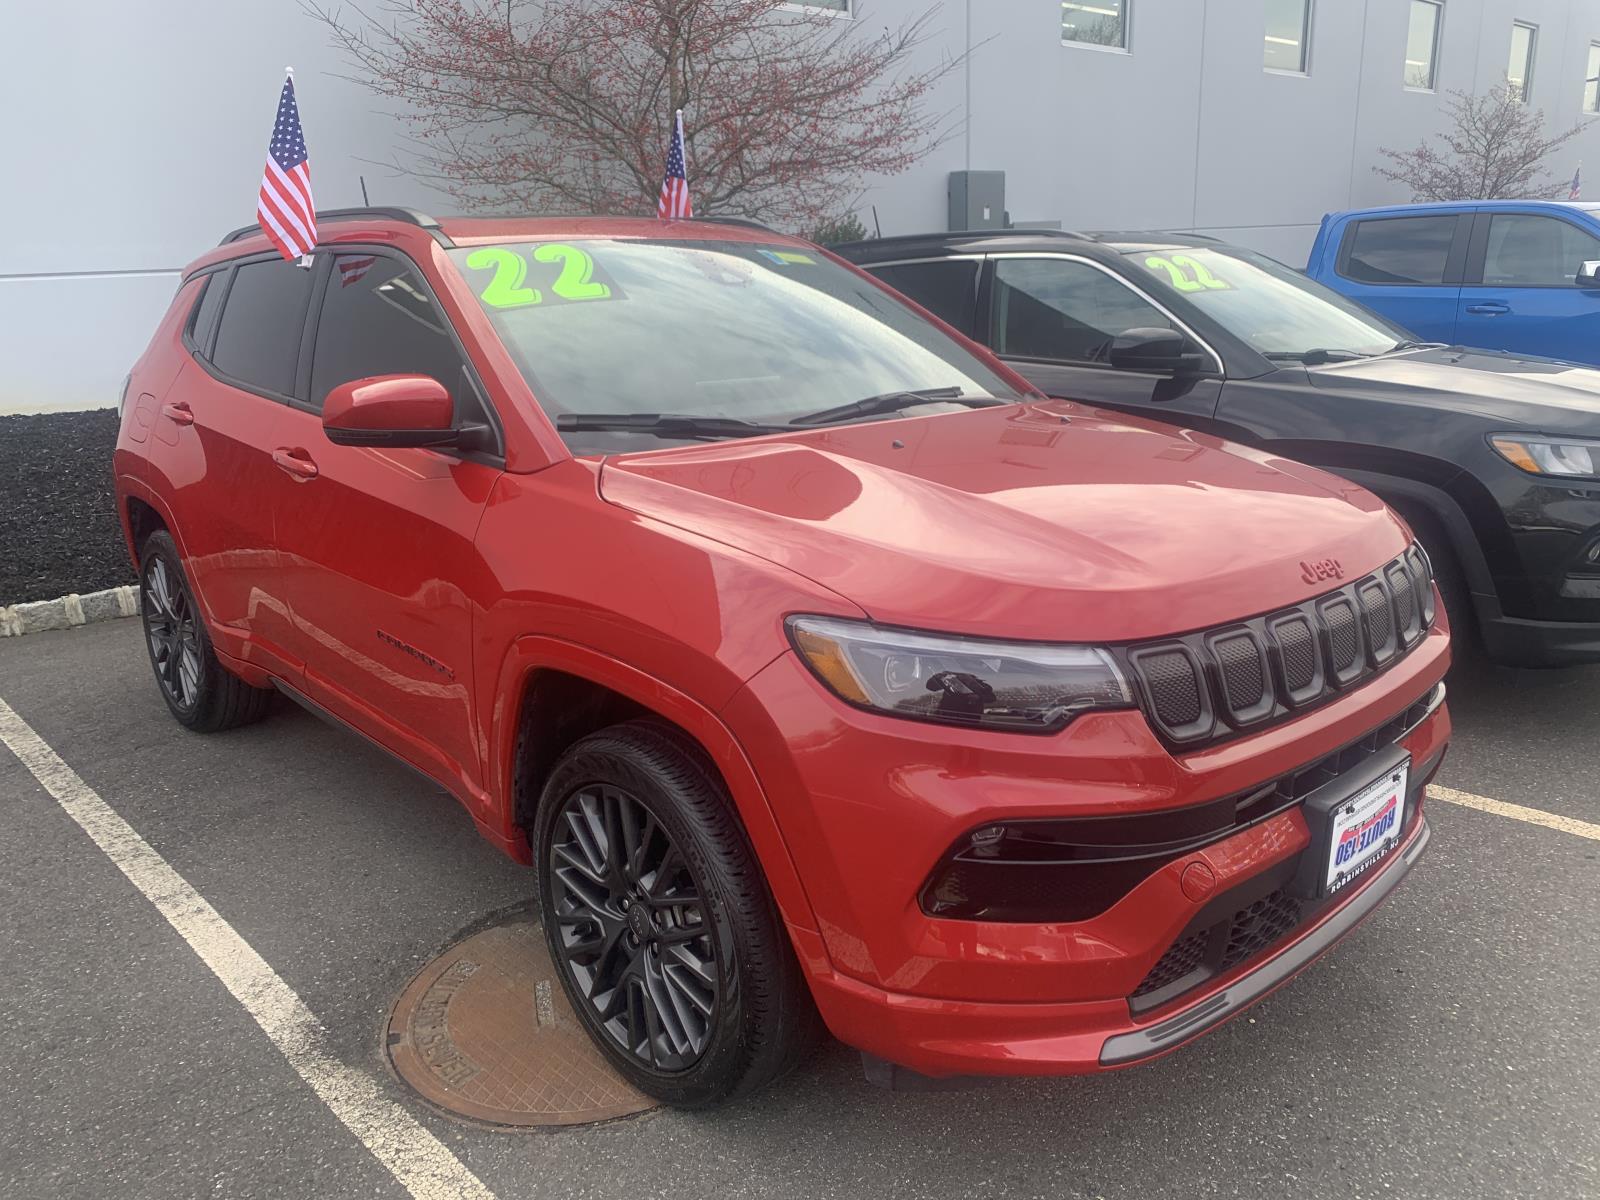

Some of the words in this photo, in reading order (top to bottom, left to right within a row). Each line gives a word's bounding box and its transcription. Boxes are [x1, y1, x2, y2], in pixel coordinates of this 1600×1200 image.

[466, 244, 611, 308] 22
[1145, 255, 1231, 291] 22
[1300, 559, 1344, 585] Jeep
[1359, 807, 1396, 852] ROUTE
[1335, 839, 1358, 866] 130
